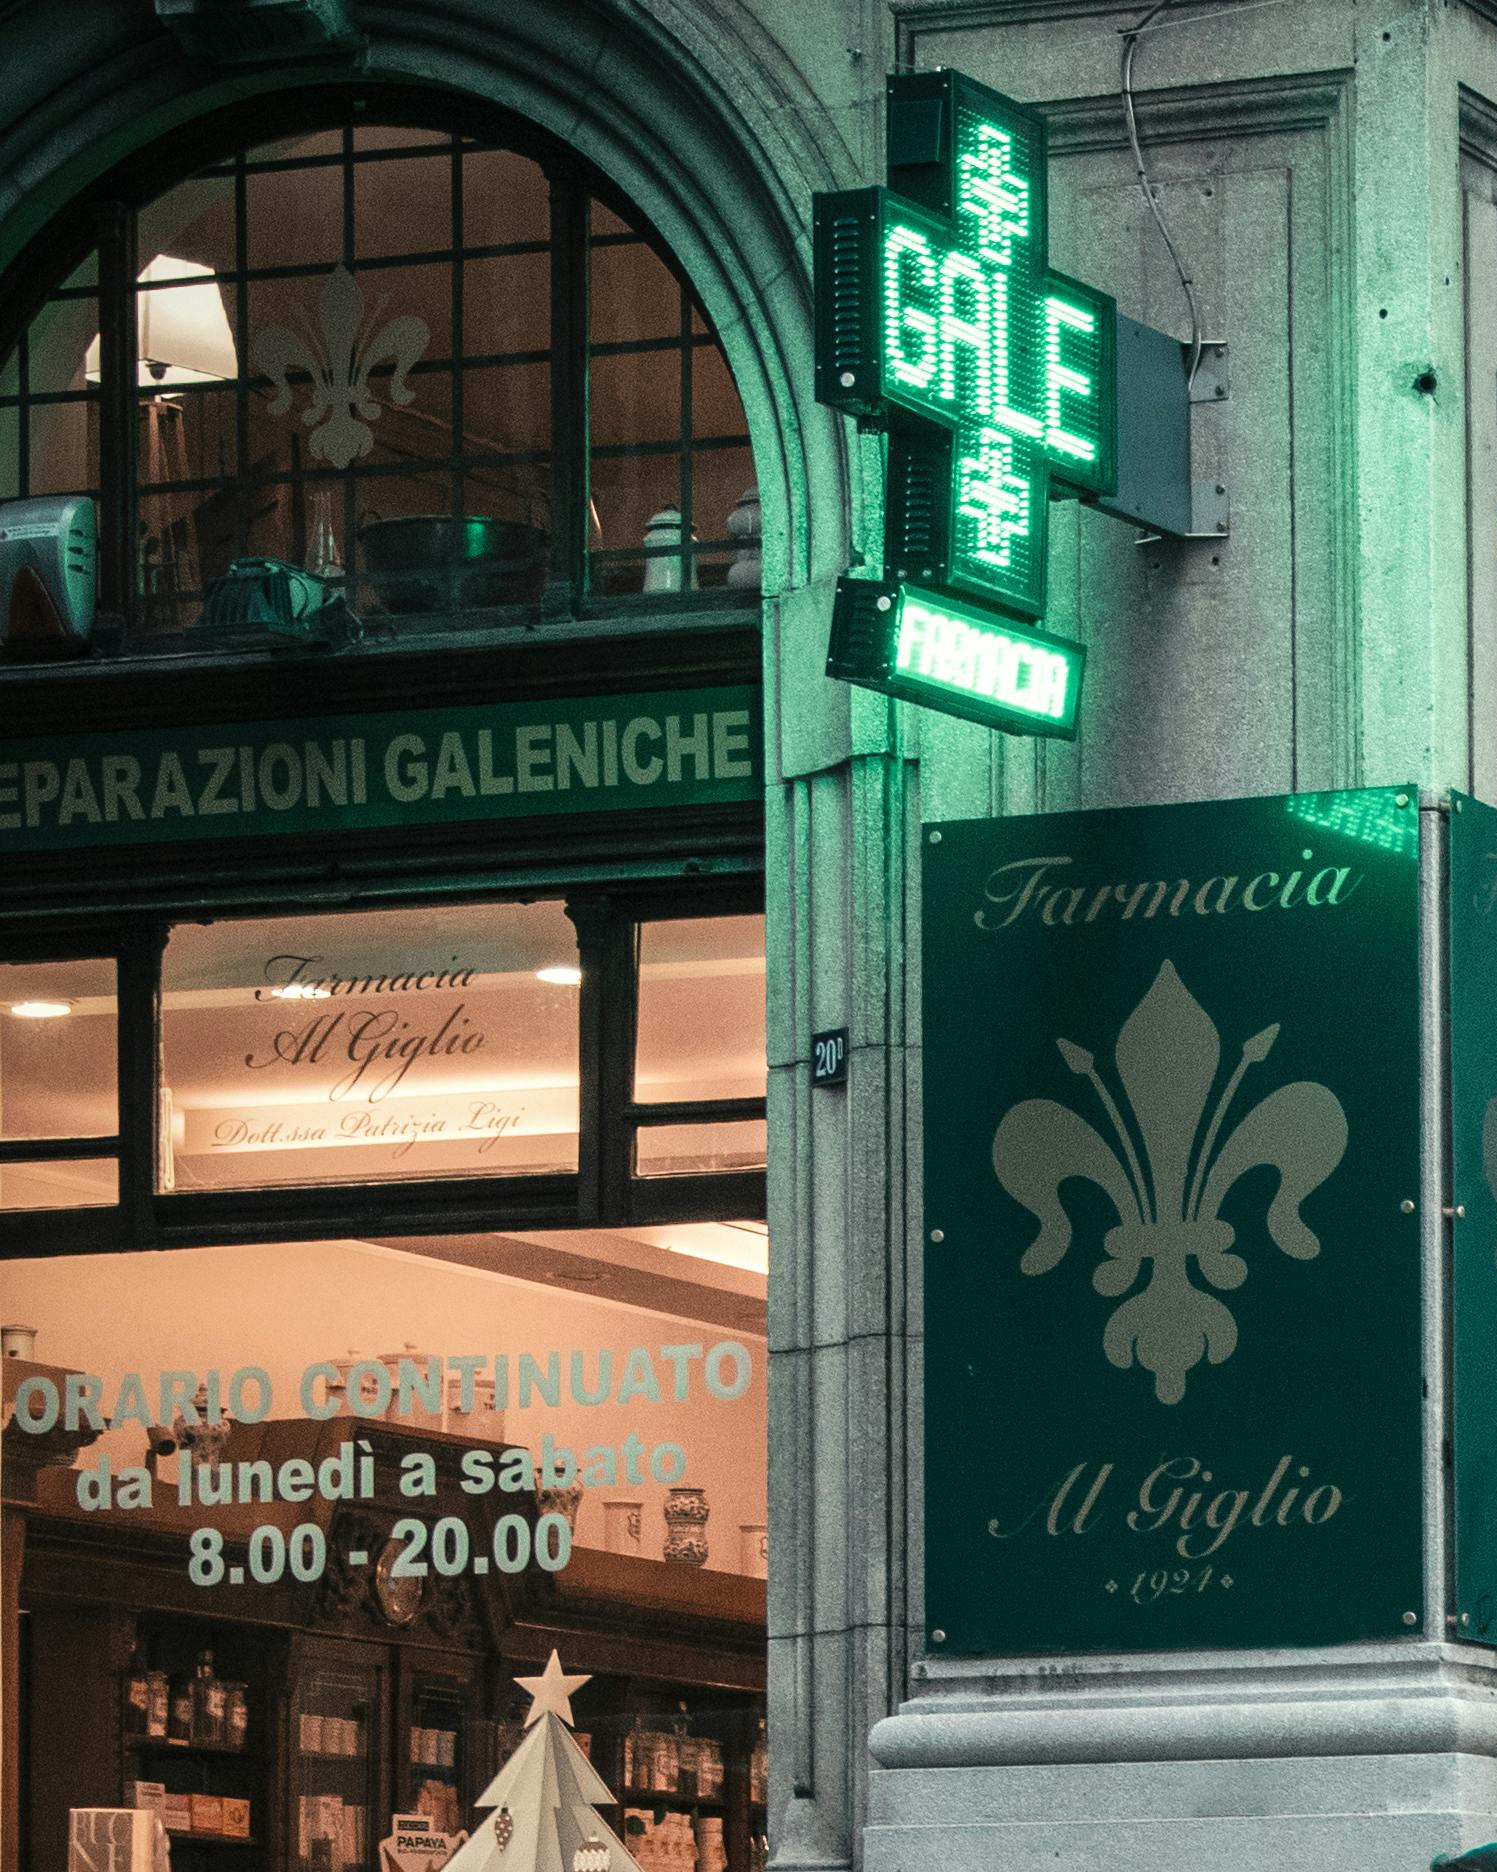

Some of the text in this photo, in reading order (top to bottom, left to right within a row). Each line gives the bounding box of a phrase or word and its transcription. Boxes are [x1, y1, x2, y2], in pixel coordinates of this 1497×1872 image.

[884, 225, 1096, 462] GALE
[384, 711, 752, 802] GALENICHE
[974, 848, 1364, 931] Farmacia
[254, 954, 476, 1003] Farmacia
[245, 1003, 486, 1104] Al Giglio
[211, 1118, 326, 1147] Dott.ssa
[335, 1110, 446, 1160] Patrizia
[15, 1340, 754, 1435] ORARIO CONTINUATO
[76, 1432, 687, 1512] da lunedì a sabato
[987, 1454, 1346, 1560] Al Giglio
[188, 1521, 328, 1587] 8.00
[391, 1512, 574, 1579] 20.00
[397, 1836, 447, 1849] PAPAYA
